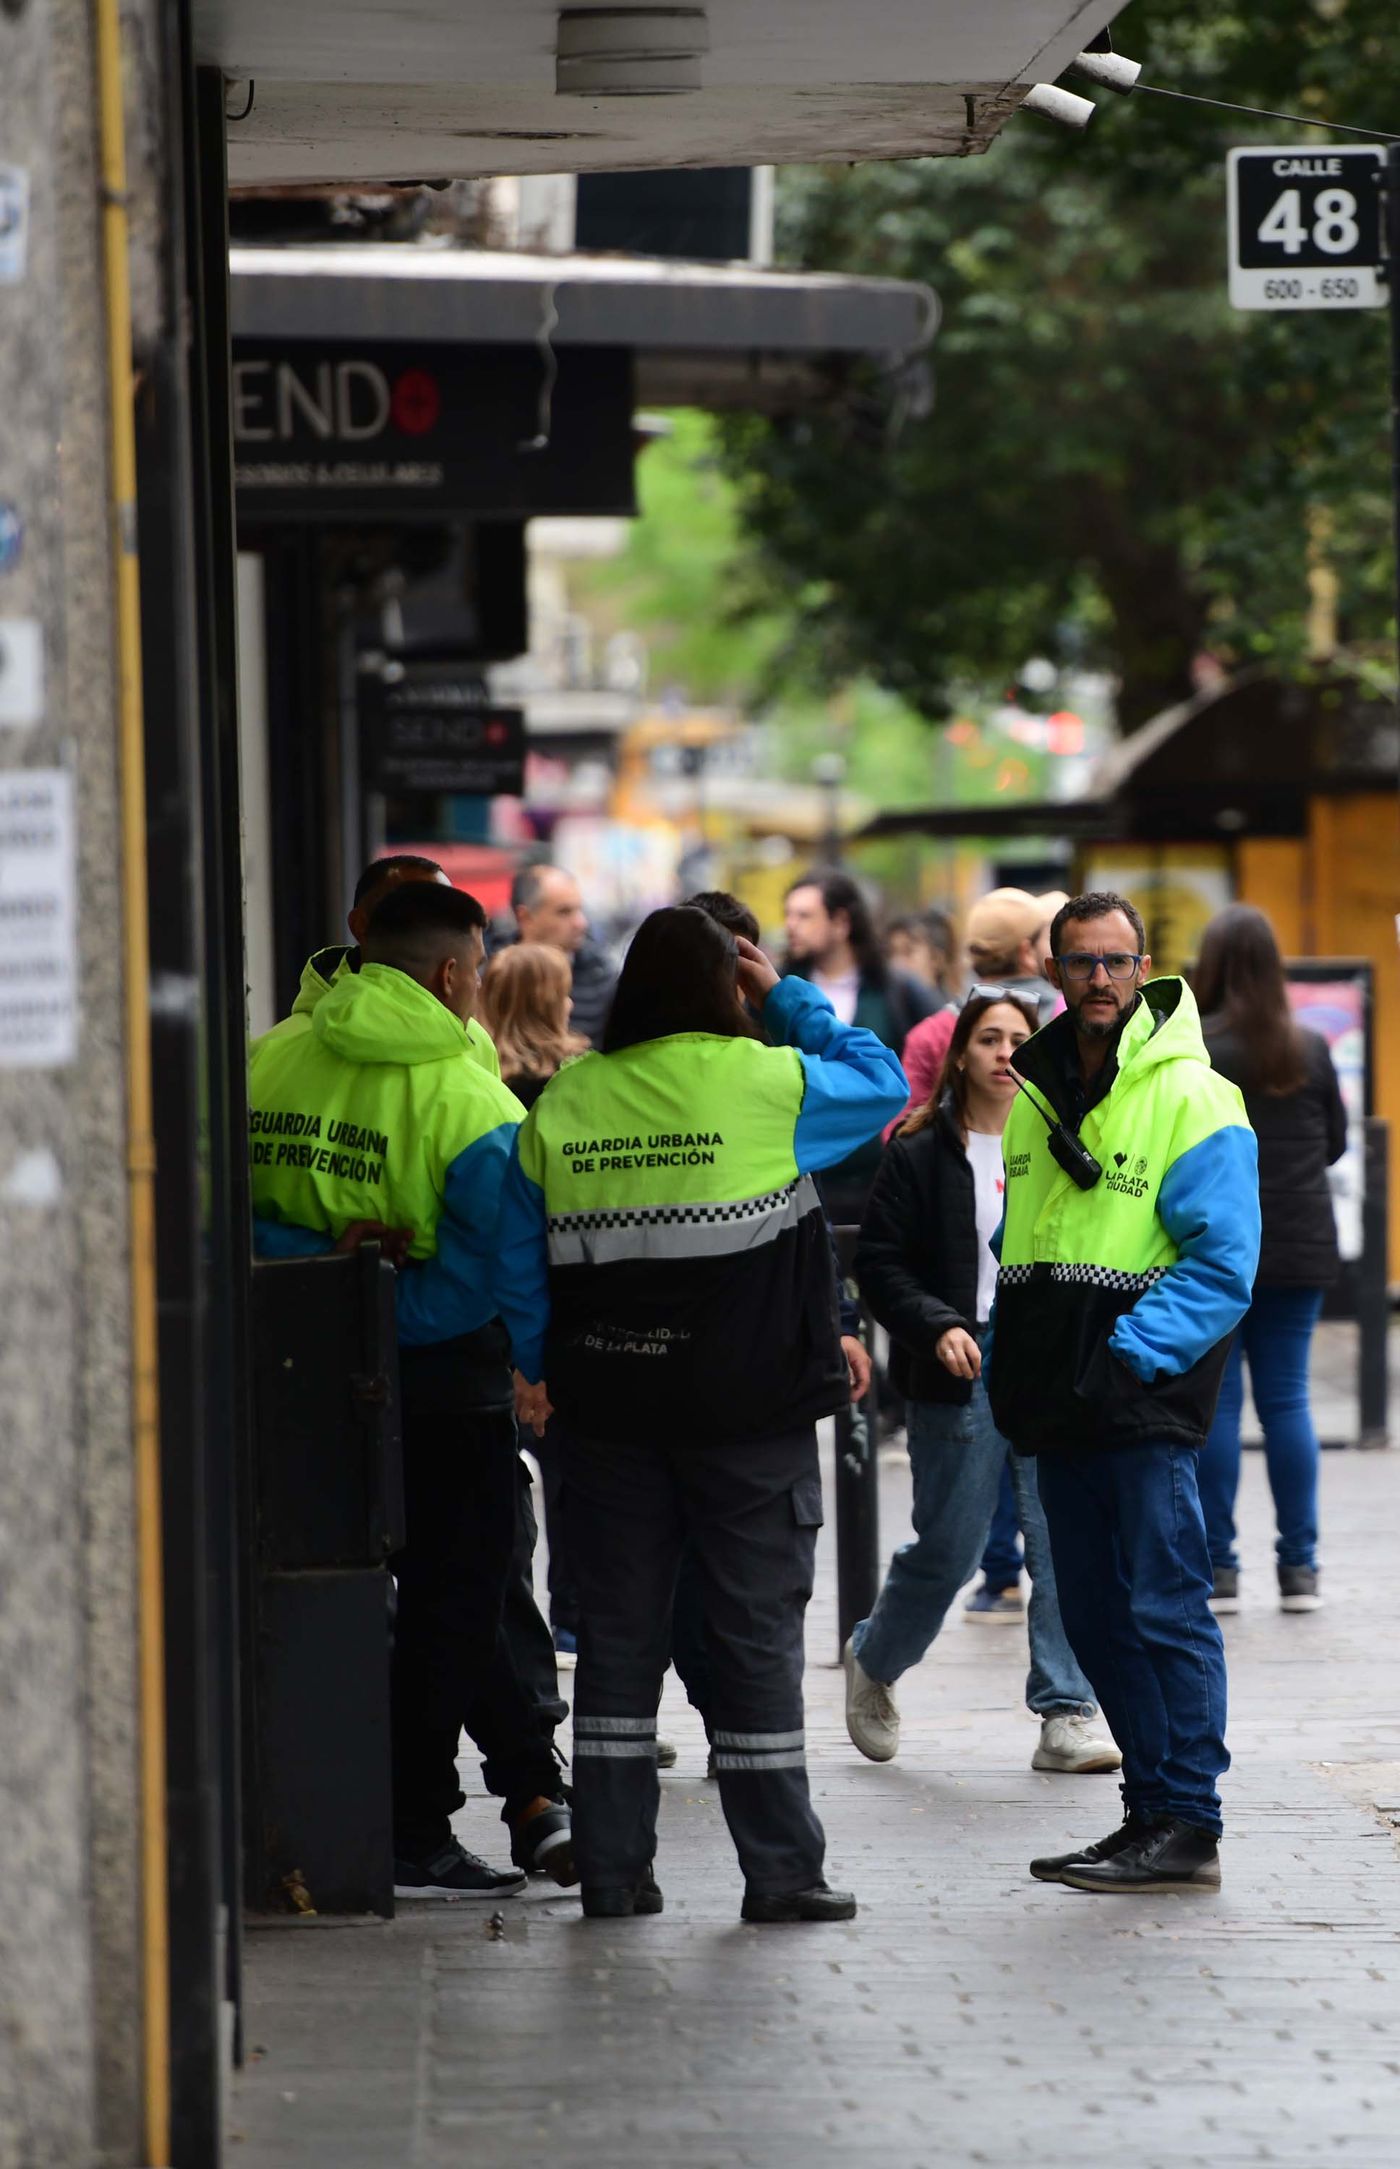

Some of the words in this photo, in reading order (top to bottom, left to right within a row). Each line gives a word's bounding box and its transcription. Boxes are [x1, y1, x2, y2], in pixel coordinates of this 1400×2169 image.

[1272, 158, 1343, 177] CALLE
[1257, 188, 1360, 254] 48
[1264, 278, 1302, 300] 600
[1320, 277, 1359, 299] 650
[249, 1110, 322, 1138] GUARDIA
[327, 1119, 389, 1158] URBANA
[562, 1136, 643, 1156] GUARDIA
[648, 1132, 724, 1149] URBANA
[253, 1142, 274, 1165] DE
[276, 1143, 382, 1185] PREVENCIÓN
[572, 1158, 595, 1174] DE
[600, 1148, 715, 1171] PREVENCIÓN
[1117, 1172, 1149, 1190] PLATA
[623, 1341, 668, 1355] PLATA
